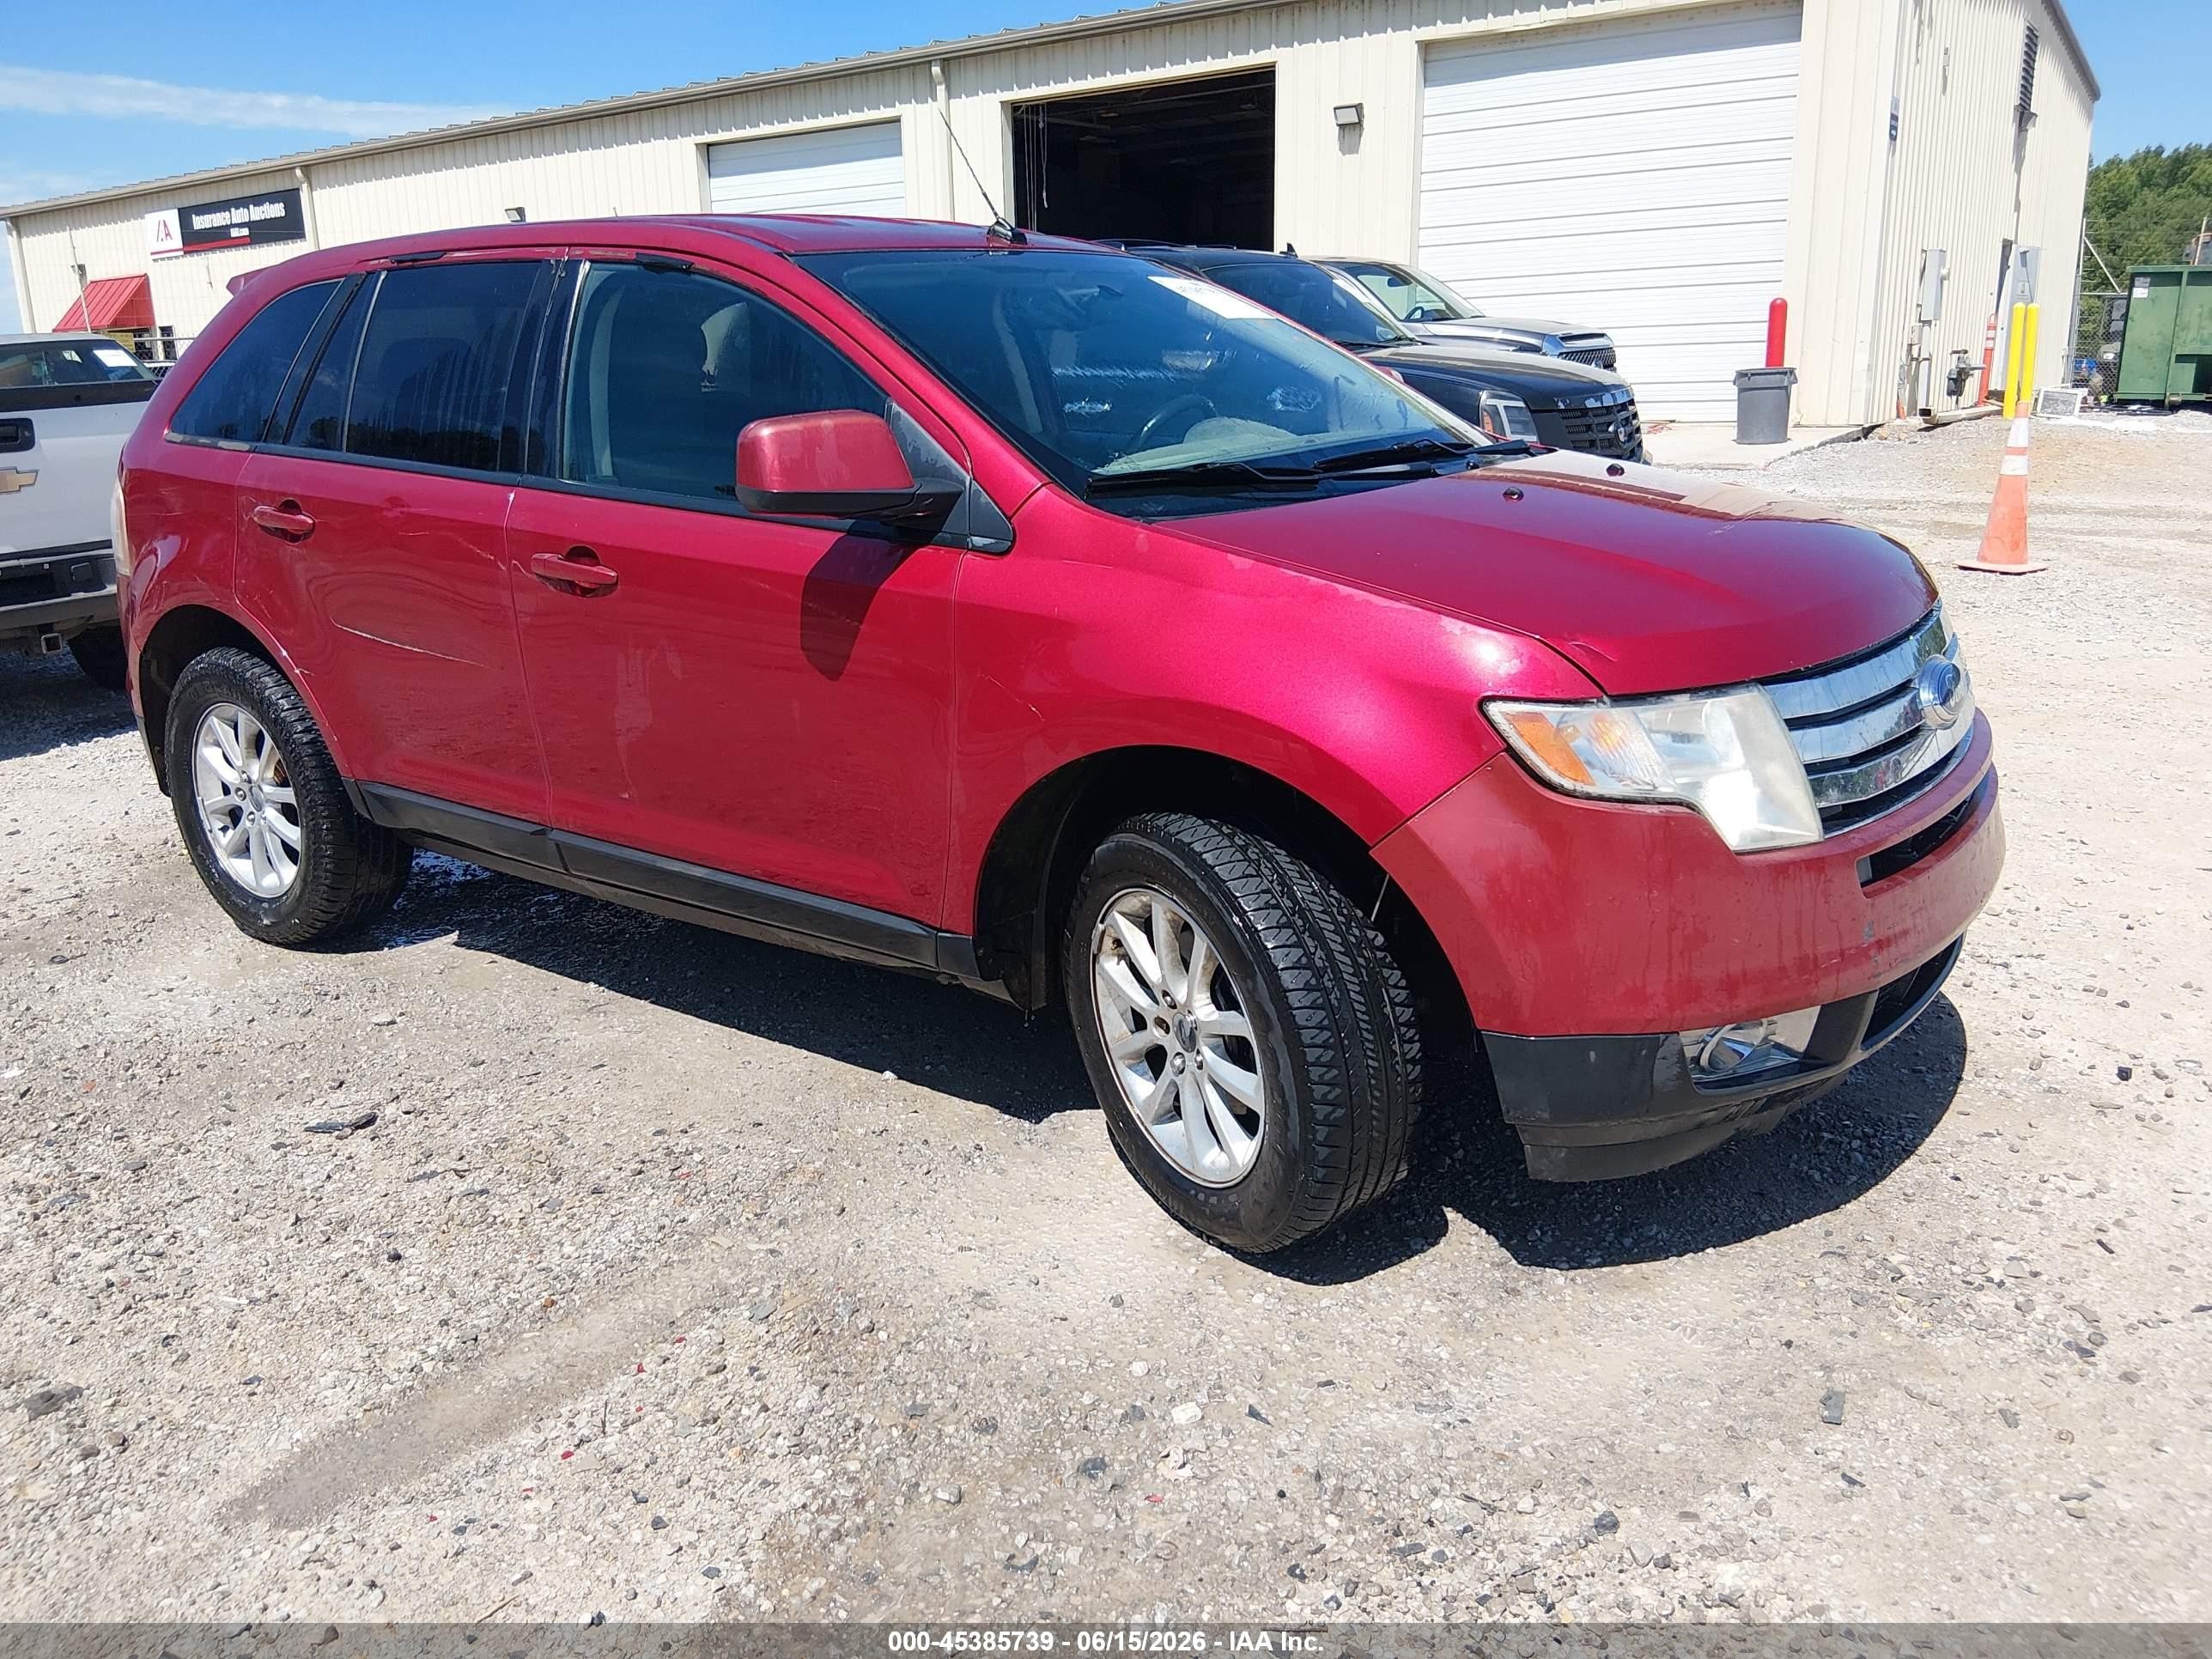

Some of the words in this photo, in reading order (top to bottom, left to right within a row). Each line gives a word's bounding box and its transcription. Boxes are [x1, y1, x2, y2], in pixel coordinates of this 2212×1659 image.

[192, 210, 230, 230] Insurance
[230, 207, 249, 224] Auto
[249, 201, 285, 222] Auctions
